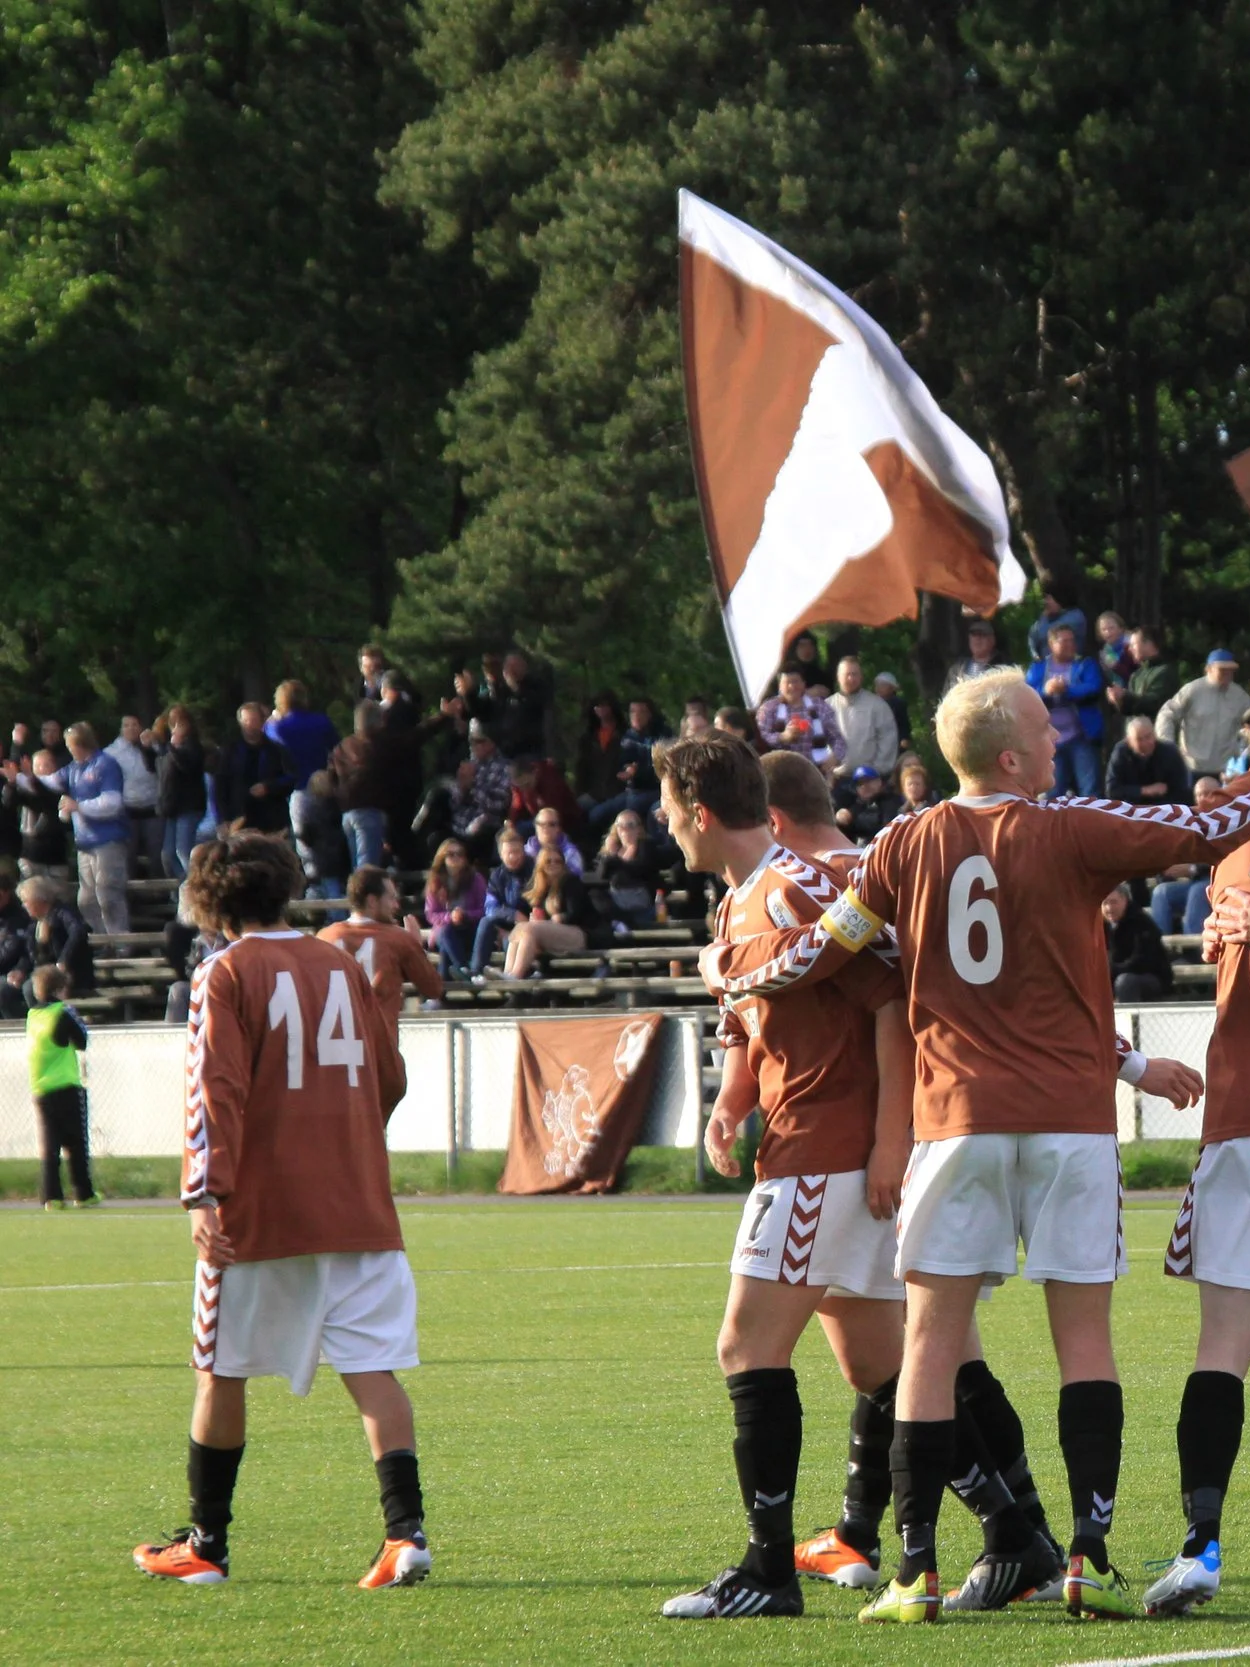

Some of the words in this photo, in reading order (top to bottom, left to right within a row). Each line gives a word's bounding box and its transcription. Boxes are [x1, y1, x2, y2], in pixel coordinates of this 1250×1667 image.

[948, 855, 1003, 985] 6
[268, 970, 365, 1089] 14
[748, 1193, 774, 1241] 7
